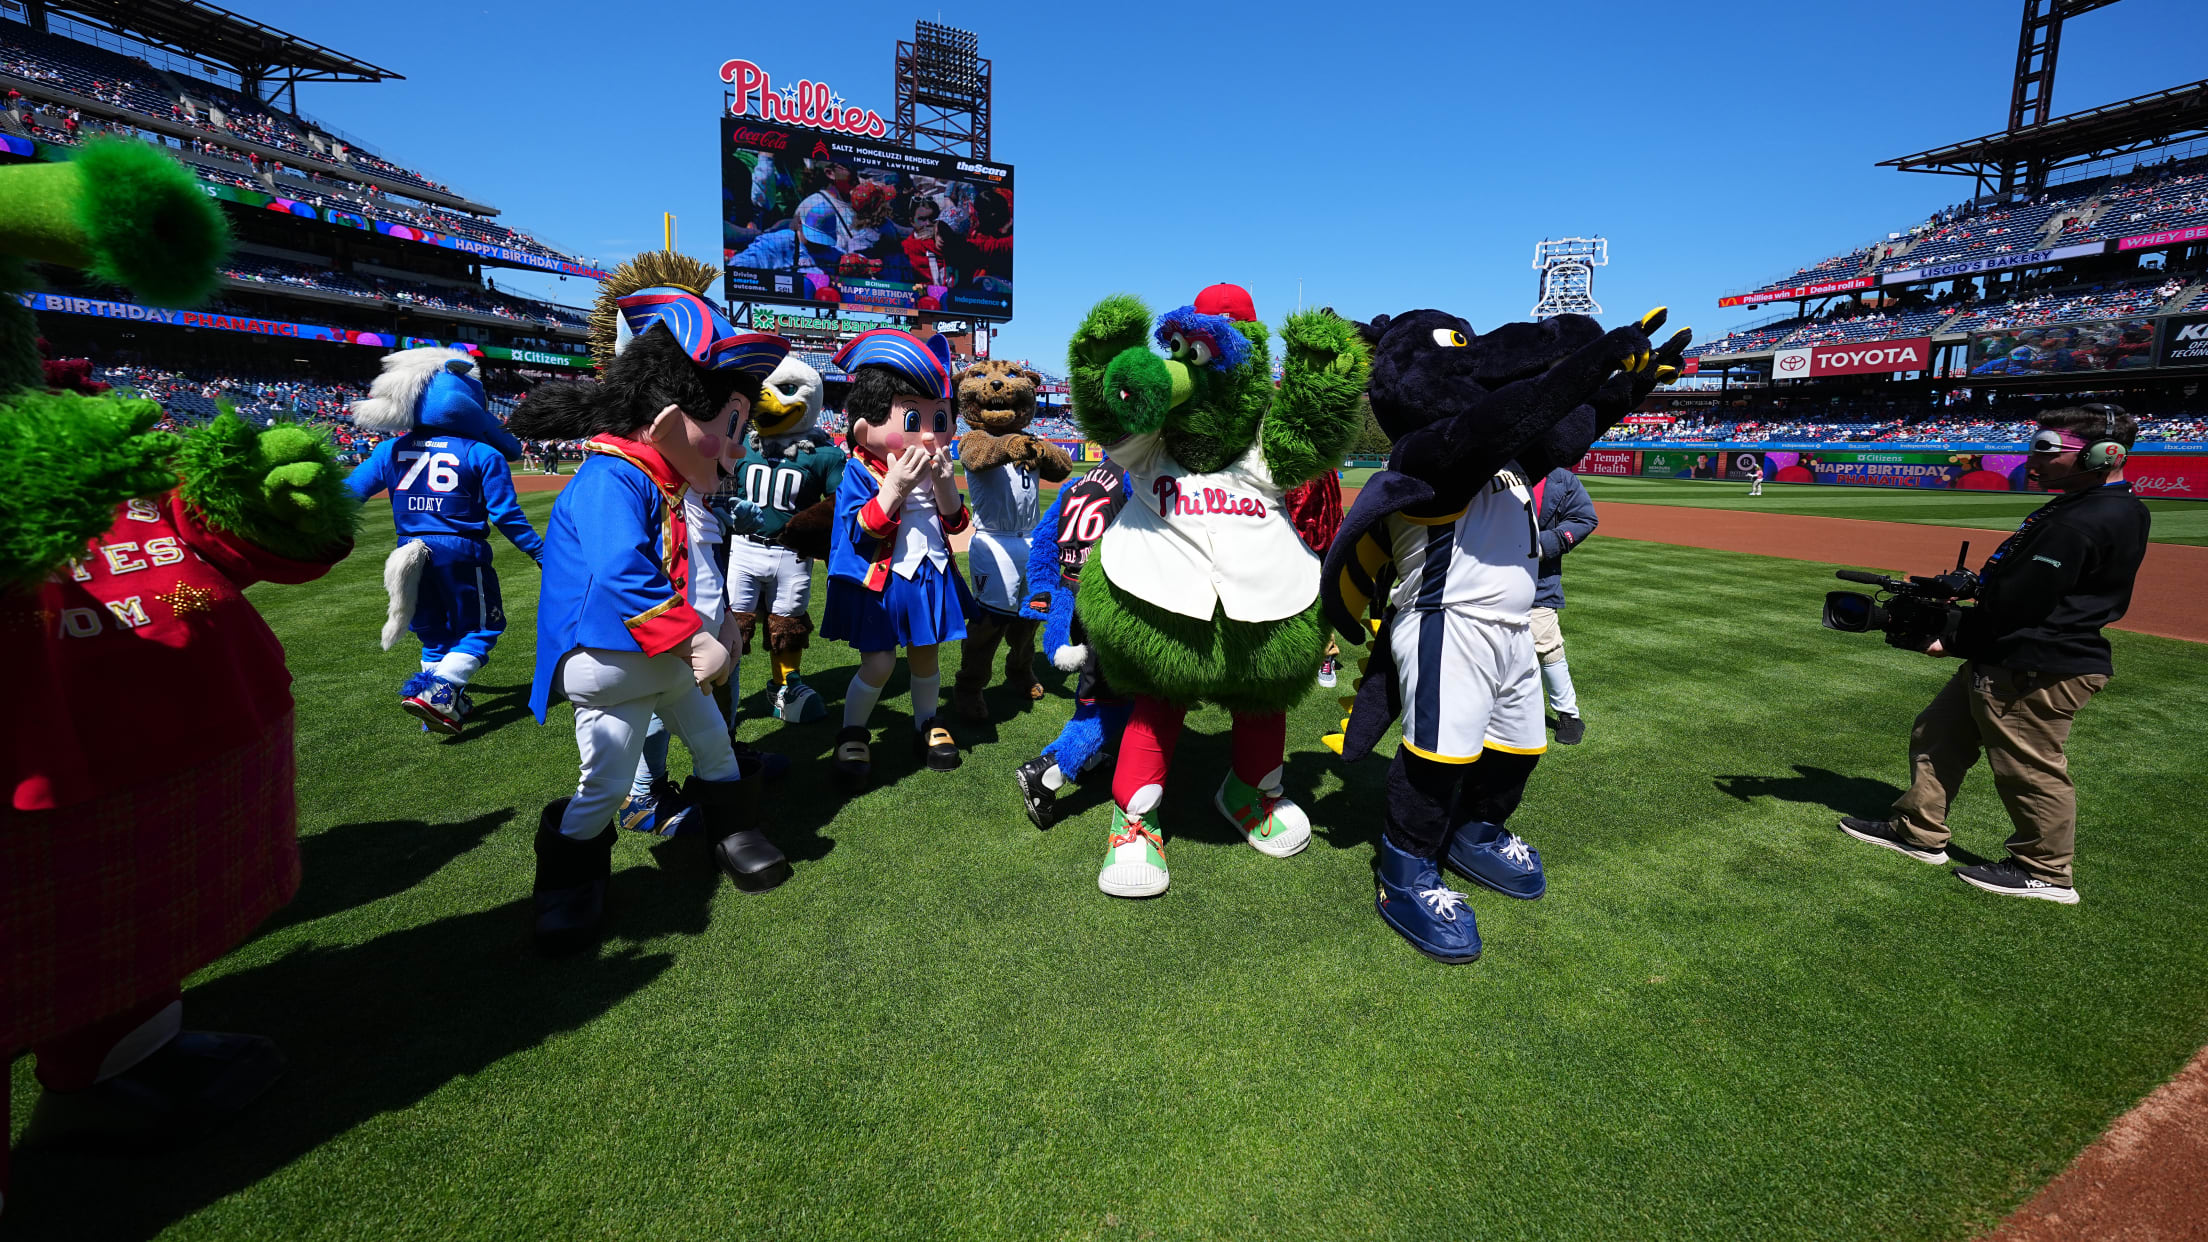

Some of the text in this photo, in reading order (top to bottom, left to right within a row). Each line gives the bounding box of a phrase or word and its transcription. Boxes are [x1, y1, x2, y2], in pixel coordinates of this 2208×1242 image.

[719, 58, 886, 138] Phillies
[733, 126, 790, 149] Coca-Cola
[831, 143, 940, 166] SALTZ MONGELUZZI BENDESKY
[853, 156, 920, 172] INJURY LAWYERS
[956, 161, 1007, 177] theScore
[2127, 232, 2180, 247] WHEY
[455, 239, 498, 257] HAPPY
[502, 250, 559, 270] BIRTHDAY
[1921, 250, 2051, 278] LISCIO'S BAKERY
[733, 271, 757, 279] Driving
[733, 284, 768, 292] outcomes.
[840, 286, 913, 298] HAPPY BIRTHDAY
[1810, 280, 1865, 294] Deals roll in
[855, 295, 900, 305] PHANATIC!
[954, 296, 1000, 306] Independence
[1743, 291, 1790, 304] Phillies win
[45, 295, 177, 324] BIRTHDAY
[183, 312, 299, 337] PHANATIC!
[778, 313, 839, 331] Citizens
[842, 319, 878, 333] Bank
[524, 352, 570, 366] Citizens
[1817, 347, 1918, 368] TOYOTA
[1594, 453, 1630, 466] Temple
[1866, 454, 1902, 463] Citizens
[396, 451, 459, 493] 76
[1593, 464, 1627, 474] Health
[1815, 463, 1948, 478] HAPPY BIRTHDAY
[746, 464, 802, 511] 00
[1836, 474, 1921, 487] PHANATIC!
[408, 496, 443, 512] COATY
[1153, 475, 1266, 518] Phillies
[1057, 494, 1111, 542] 76
[58, 596, 151, 639] OM
